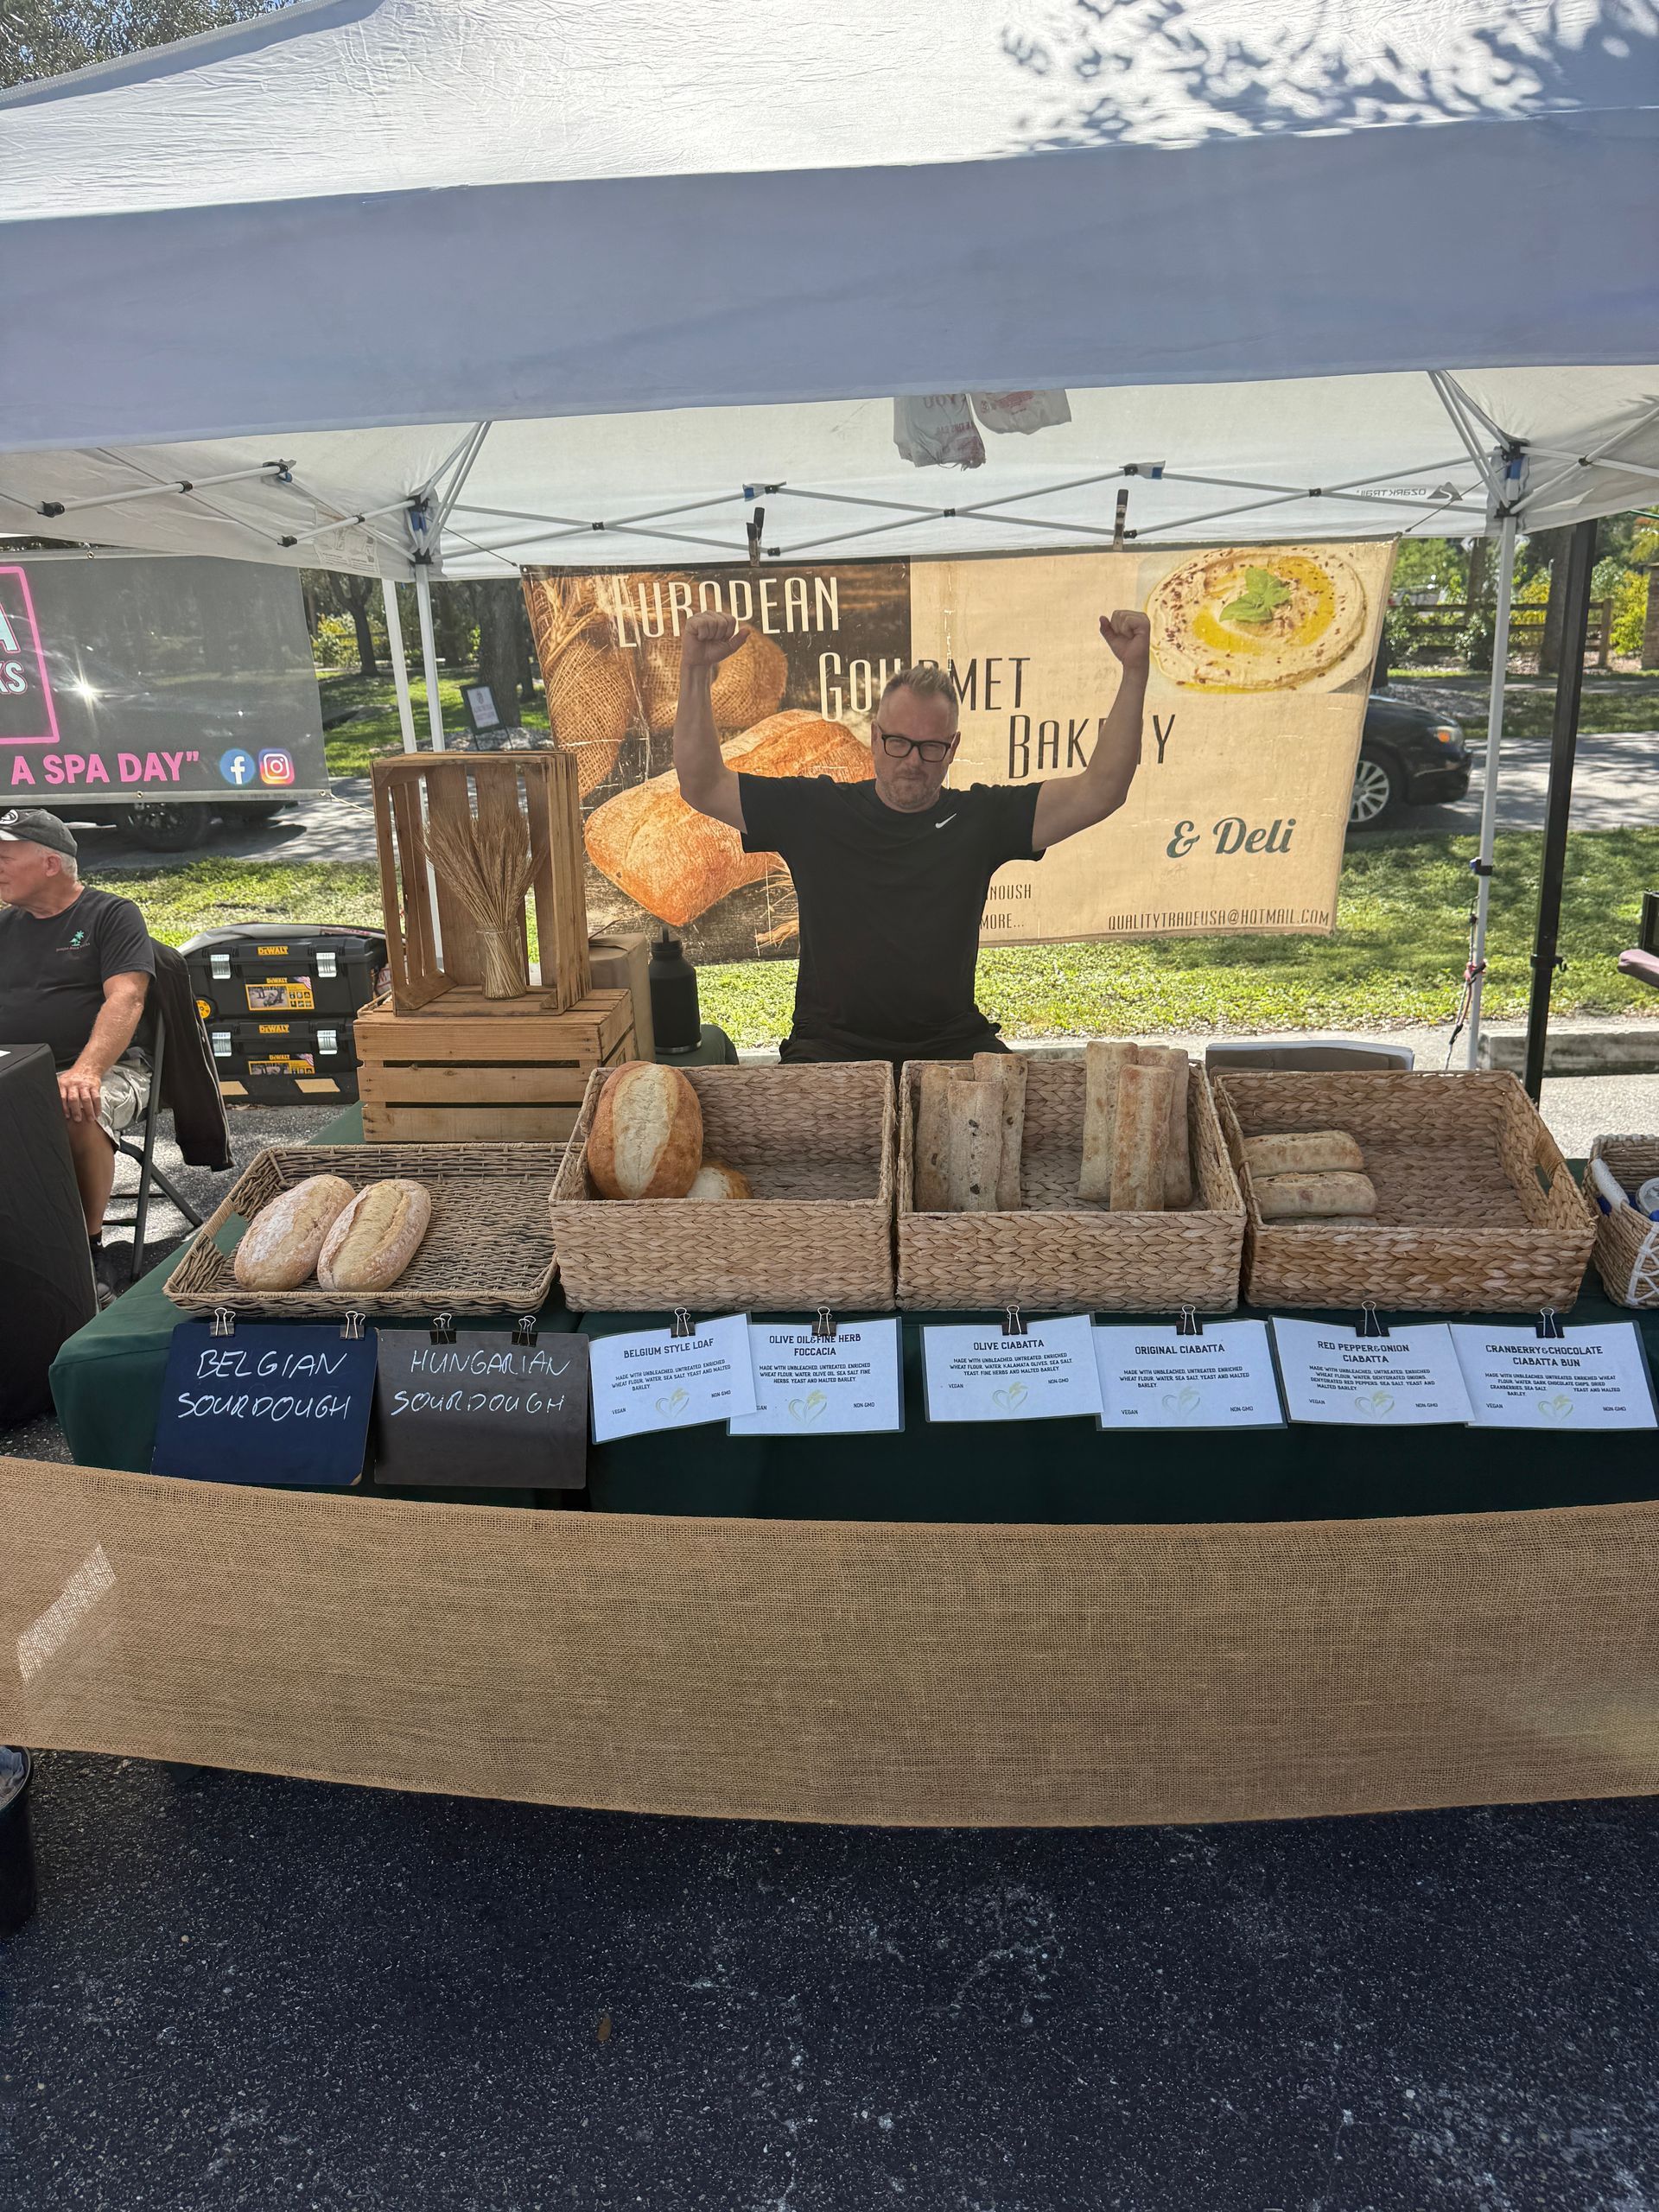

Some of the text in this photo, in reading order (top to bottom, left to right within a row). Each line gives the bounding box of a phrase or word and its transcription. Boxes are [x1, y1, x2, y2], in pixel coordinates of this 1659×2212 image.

[818, 652, 1031, 722] GOMET
[1008, 714, 1176, 779] BAKY
[10, 755, 35, 785] A
[42, 753, 111, 785] SPA
[1166, 817, 1297, 859] & Deli
[986, 883, 1032, 900] NOUSH
[1108, 908, 1330, 931] QUALITYTRADEUSA@HOTMAIL.COM
[624, 1338, 714, 1358] BELGIUM STYLE LOAF
[838, 1333, 861, 1342] HERB
[1001, 1339, 1044, 1349] CIABATTA
[1317, 1341, 1409, 1351] RED PEPPER&ONION
[794, 1347, 836, 1356] FOCCACIA
[1179, 1344, 1224, 1353] CIABATTA
[1485, 1344, 1603, 1354] CRANBERRY&CHOCOLATE
[196, 1349, 347, 1379] BELGIAN
[410, 1350, 571, 1376] HUNGARIAN
[1512, 1357, 1558, 1365] CIABATTA
[177, 1392, 351, 1421] SOURDOUGH
[391, 1390, 565, 1415] SOURDOUGH
